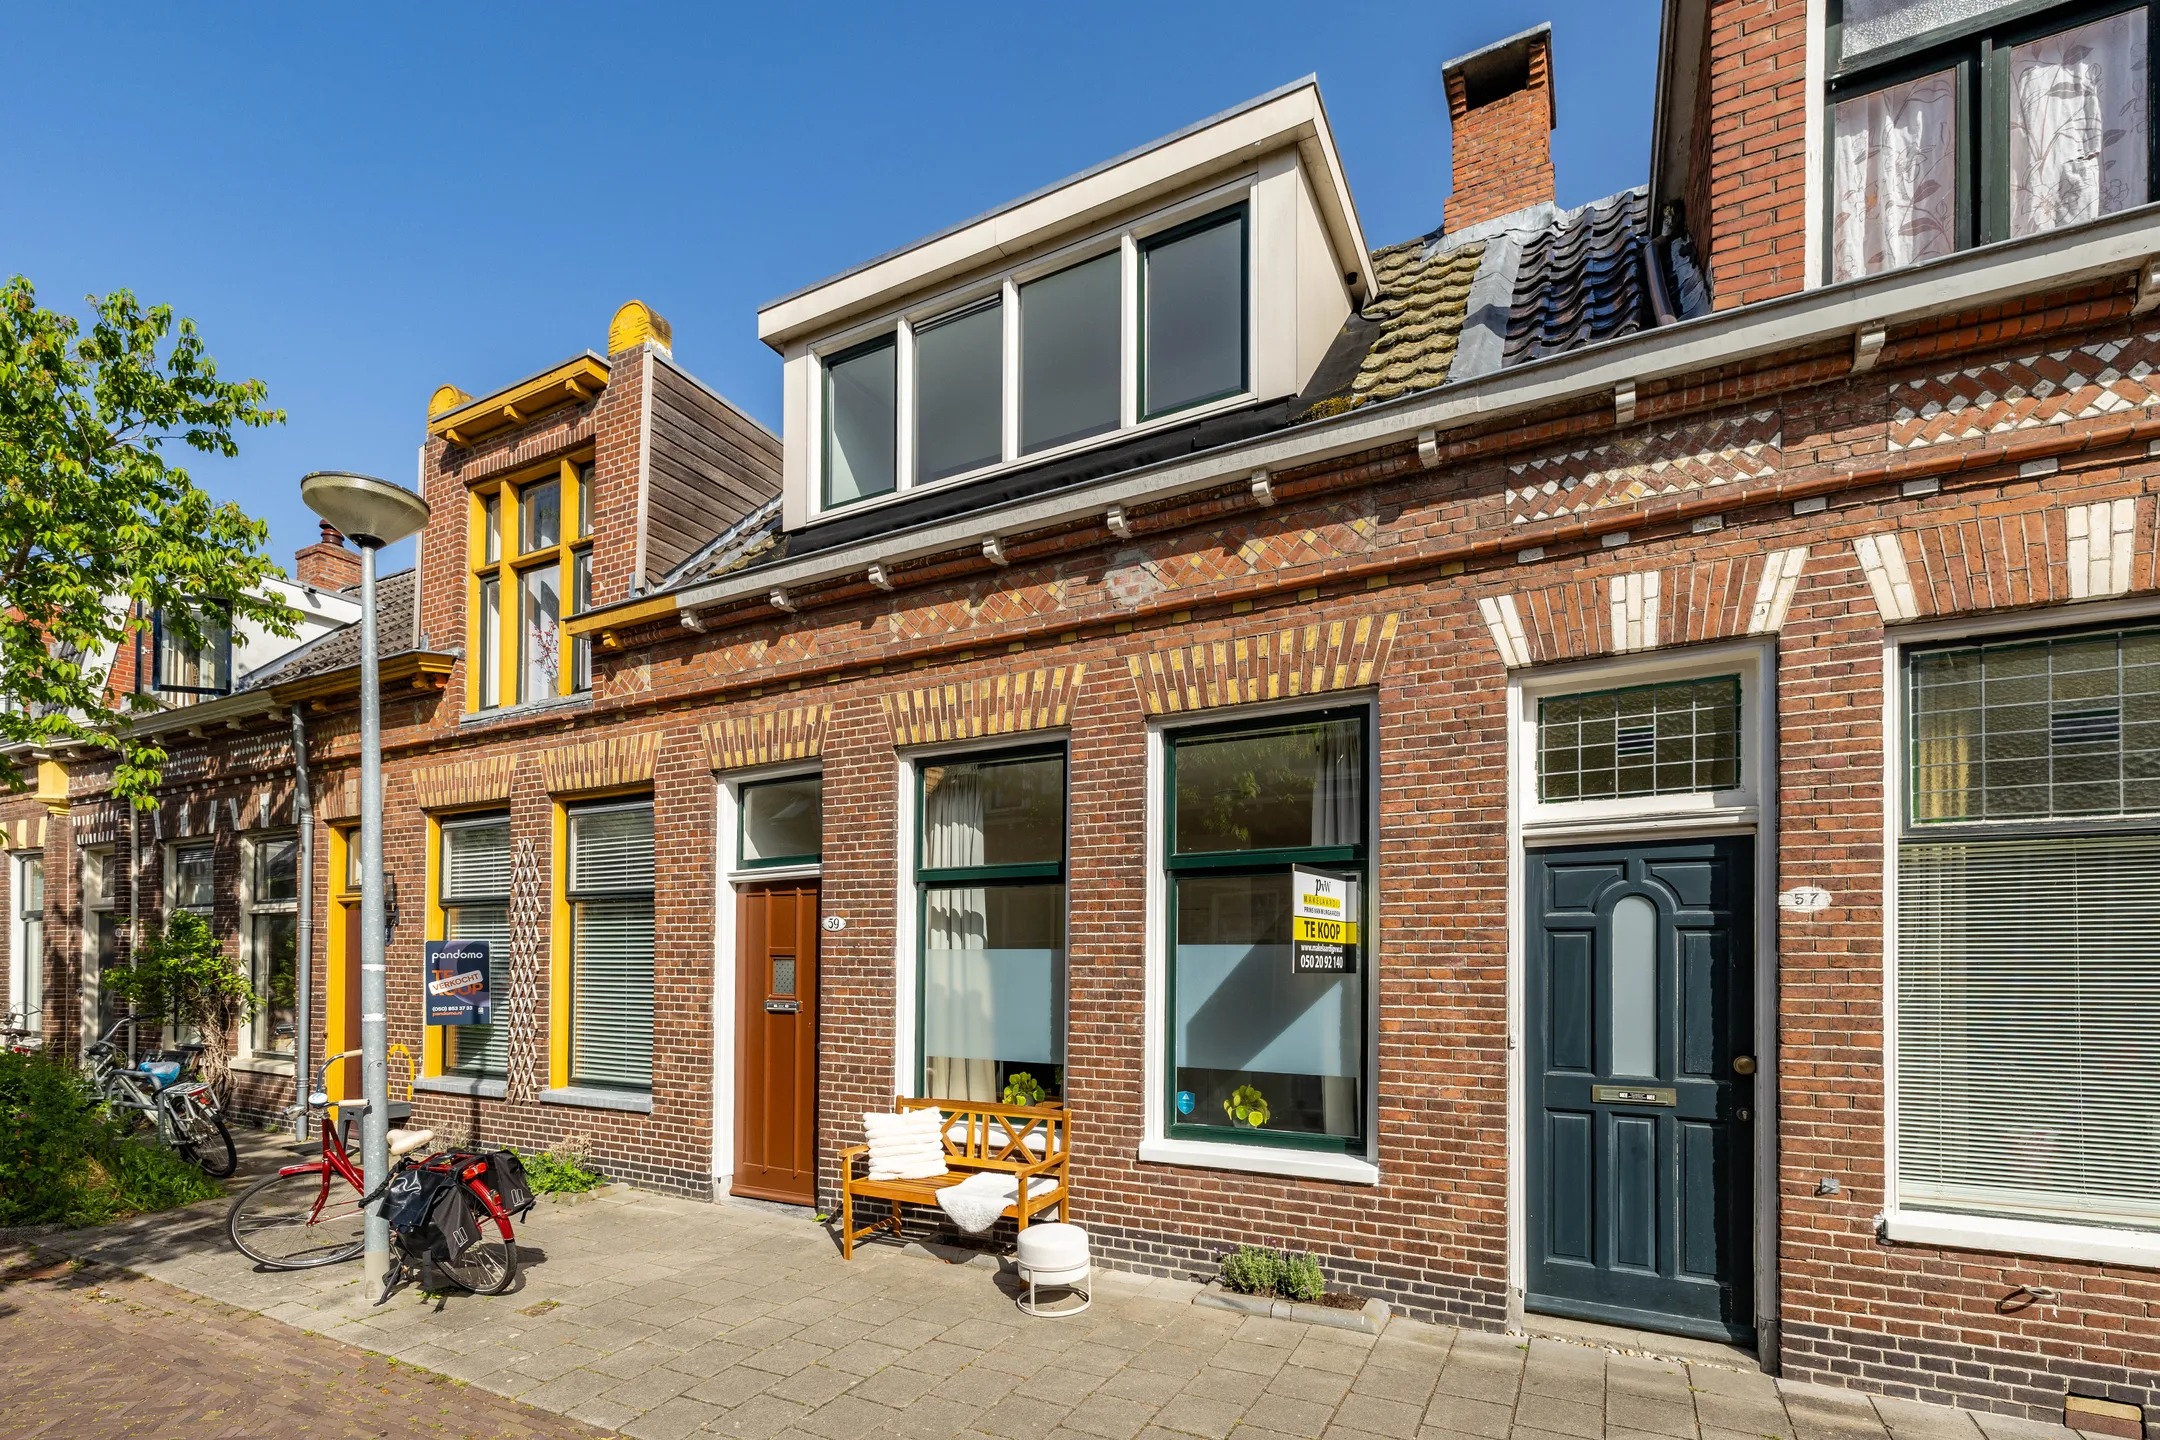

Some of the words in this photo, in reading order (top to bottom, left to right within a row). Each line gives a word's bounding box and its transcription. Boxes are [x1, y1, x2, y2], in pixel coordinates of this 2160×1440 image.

[1303, 895, 1341, 908] MAKELAARDIJ
[1794, 893, 1819, 905] 57
[828, 918, 840, 929] 59
[1304, 920, 1316, 938] TE
[1317, 922, 1341, 940] KOOP
[431, 949, 484, 964] pandomo
[1300, 954, 1315, 969] 050
[1314, 954, 1324, 969] 20
[1324, 955, 1333, 969] 92
[1333, 956, 1344, 969] 140
[432, 973, 480, 991] VERKOCHT
[432, 1005, 448, 1013] (050)
